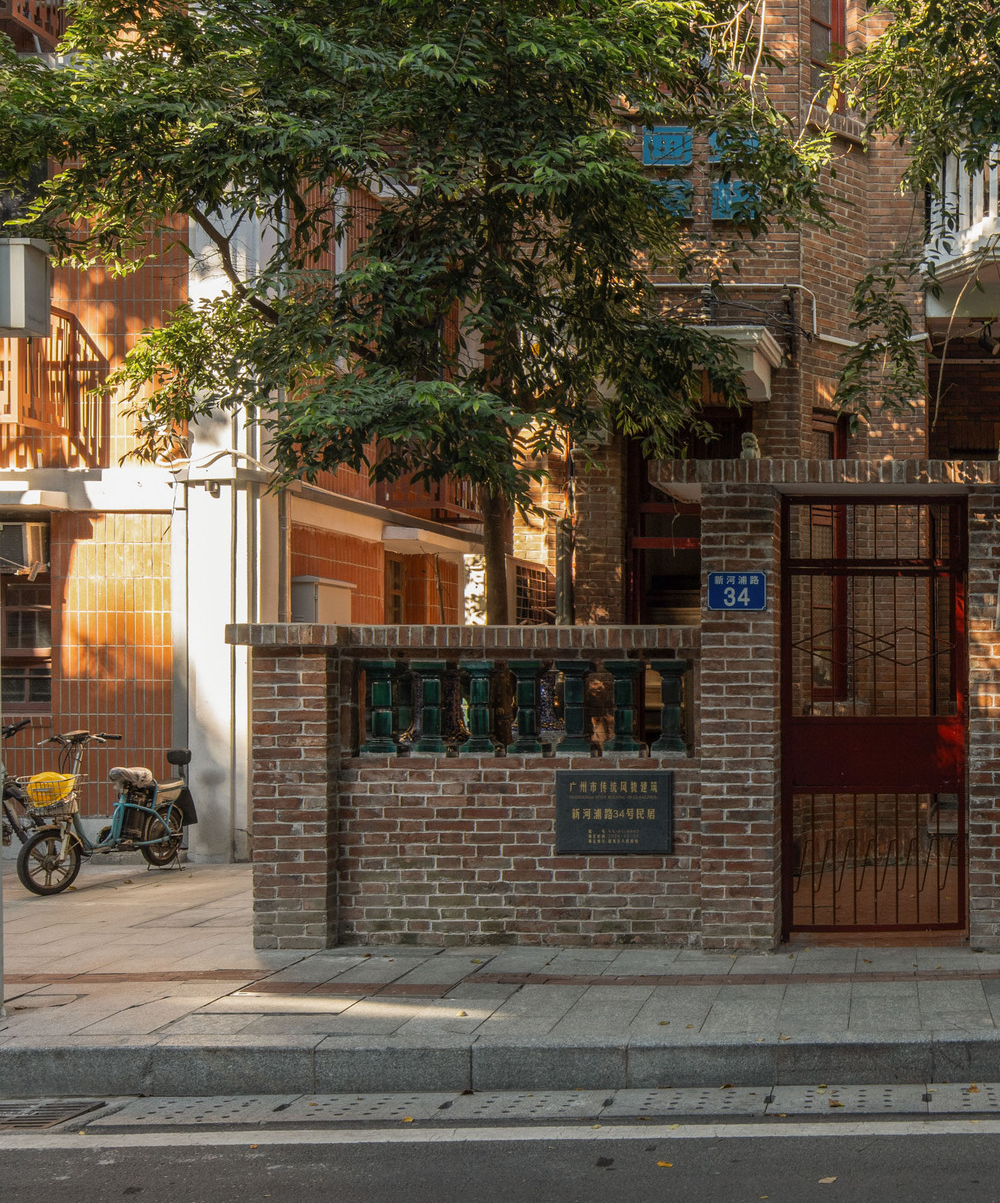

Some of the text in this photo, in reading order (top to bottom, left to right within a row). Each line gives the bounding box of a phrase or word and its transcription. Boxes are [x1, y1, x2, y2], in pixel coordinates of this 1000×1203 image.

[714, 575, 760, 585] 新河浦路
[723, 586, 751, 607] 34
[569, 781, 658, 794] 广州市传统风貌建筑
[571, 808, 656, 820] 新河浦路34号民居
